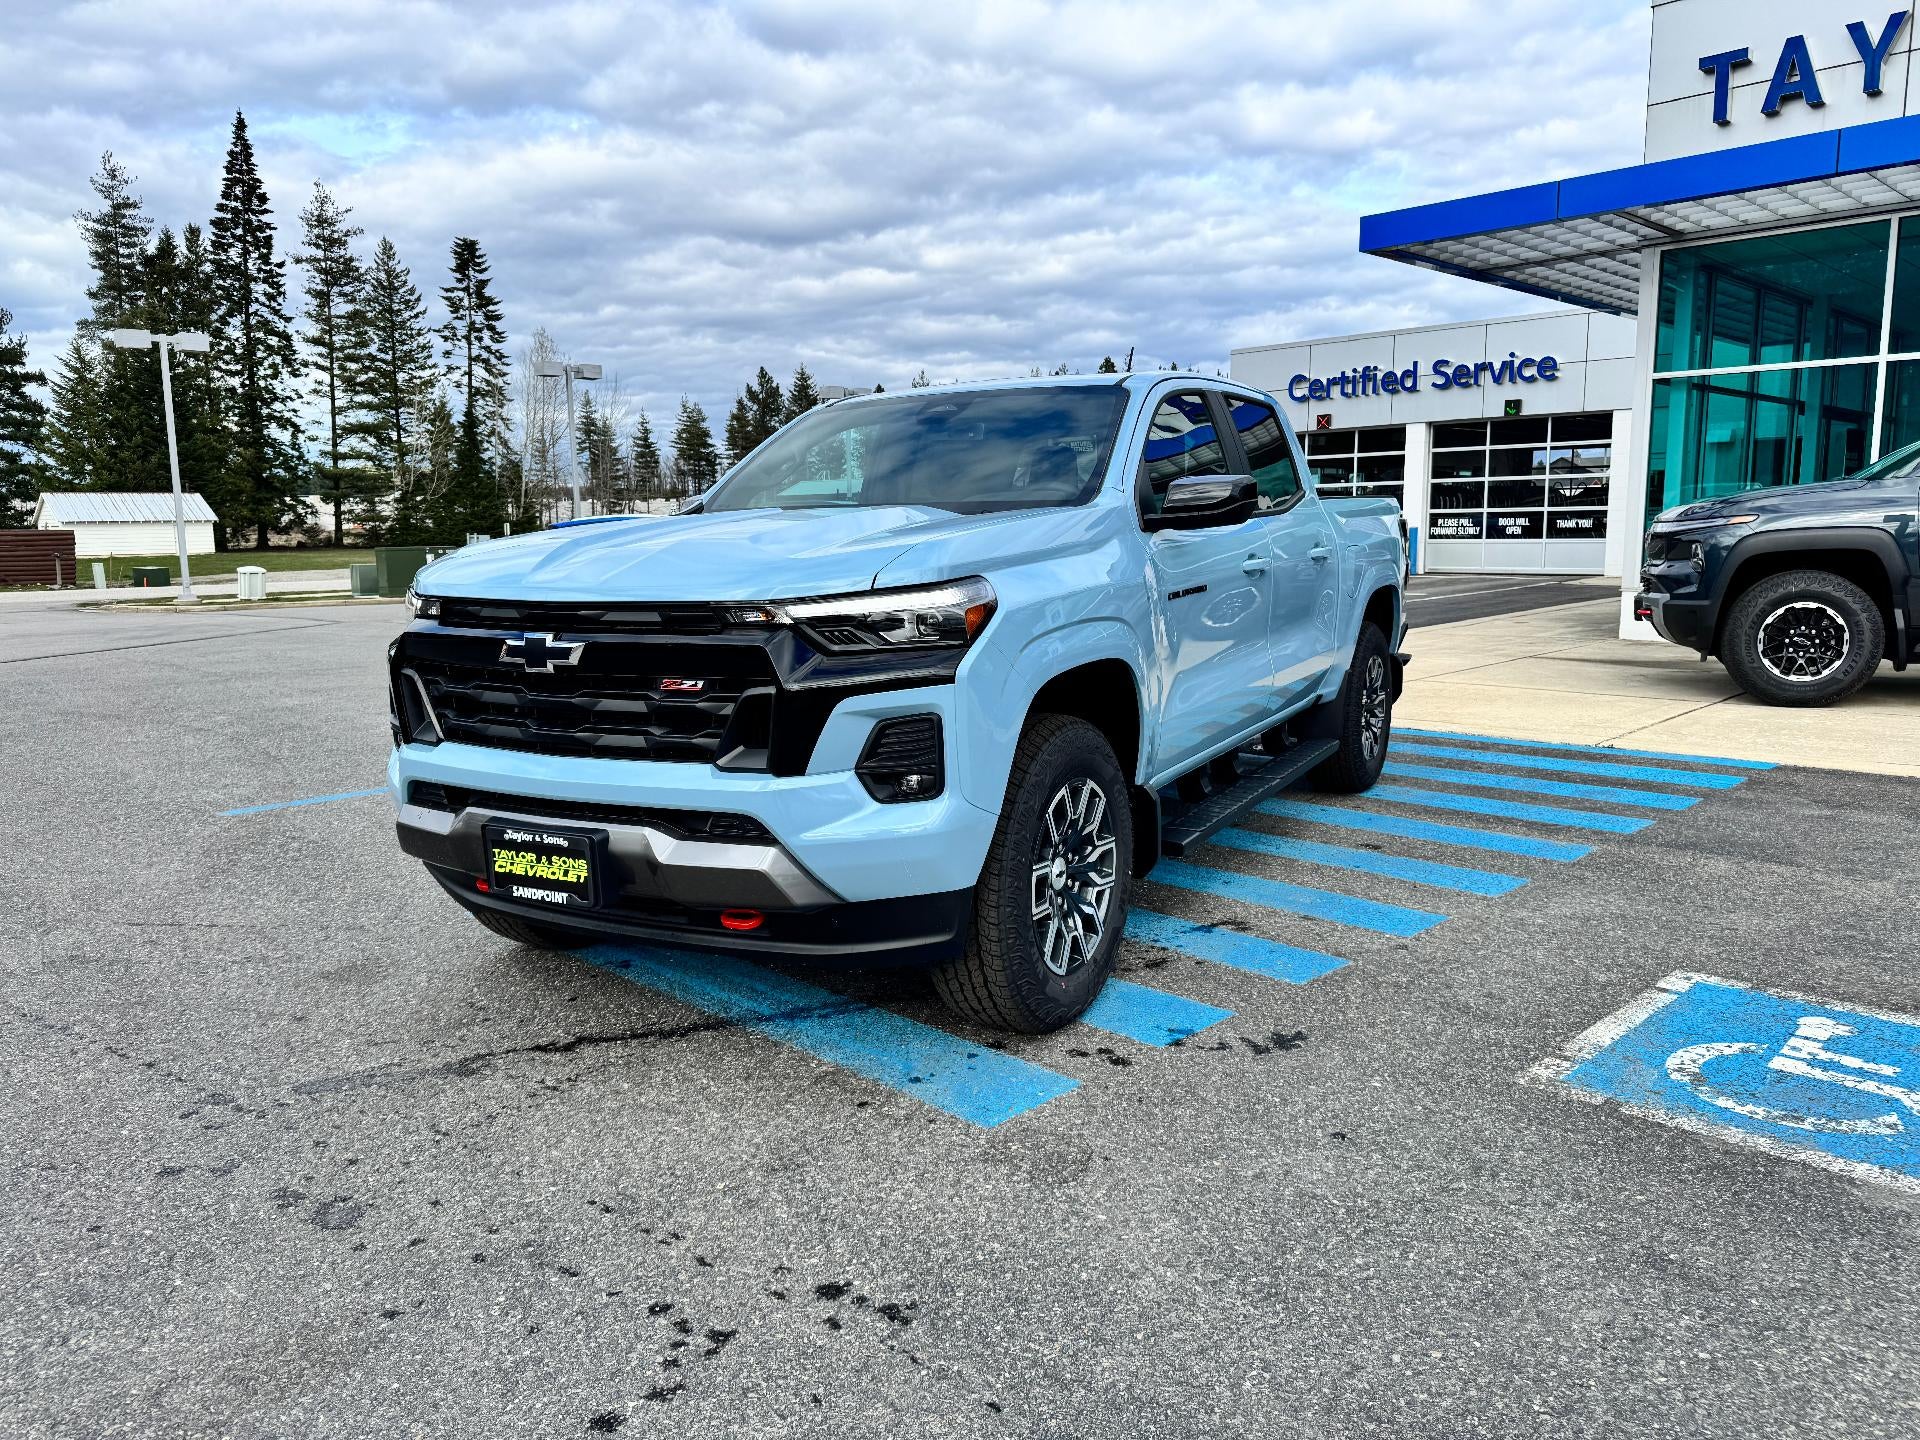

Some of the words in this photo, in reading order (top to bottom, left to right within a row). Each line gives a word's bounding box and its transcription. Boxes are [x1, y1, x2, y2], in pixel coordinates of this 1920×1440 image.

[1699, 9, 1909, 125] TAY
[1288, 360, 1419, 401] Certified
[1431, 351, 1559, 389] Service
[1437, 518, 1458, 527] PLEASE
[1459, 518, 1474, 527] PULL
[1498, 517, 1515, 526] DOOR
[1516, 517, 1530, 526] WILL
[1556, 519, 1578, 529] THANK
[1578, 518, 1593, 528] YOU!
[1430, 526, 1457, 536] FORWARD
[1458, 526, 1480, 535] SLOWLY
[1506, 526, 1522, 535] OPEN
[660, 679, 705, 691] Z71
[507, 829, 534, 842] Taylor
[543, 834, 564, 846] Sons
[492, 848, 537, 864] TAYLOR
[540, 855, 548, 866] &
[551, 855, 588, 870] SONS
[494, 861, 588, 883] CHEVROLET
[512, 885, 569, 905] SANDPOINT
